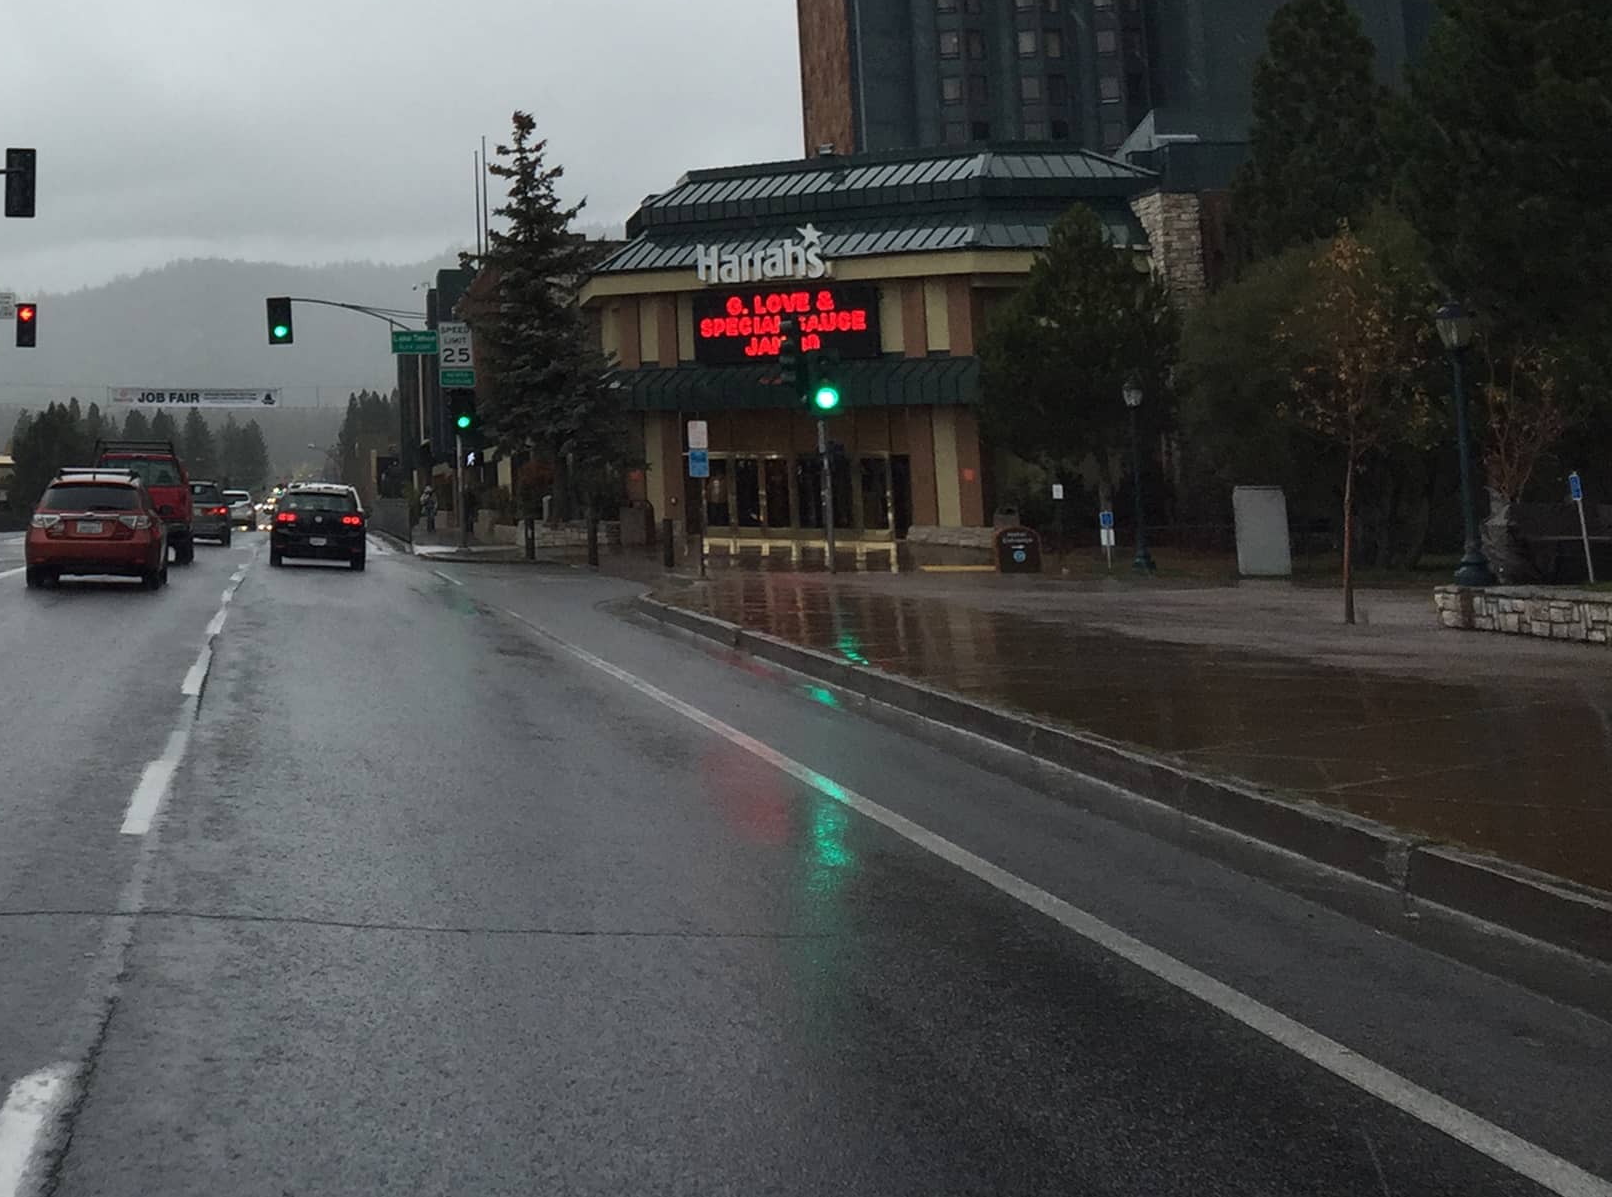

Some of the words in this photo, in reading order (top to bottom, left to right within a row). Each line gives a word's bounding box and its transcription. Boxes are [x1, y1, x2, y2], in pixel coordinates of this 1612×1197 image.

[753, 291, 811, 315] LOVE
[816, 290, 835, 311] &
[441, 326, 469, 334] SPEED
[444, 336, 466, 344] LIMIT
[443, 348, 470, 363] 25
[138, 392, 165, 404] JOB
[169, 392, 200, 404] FAIR
